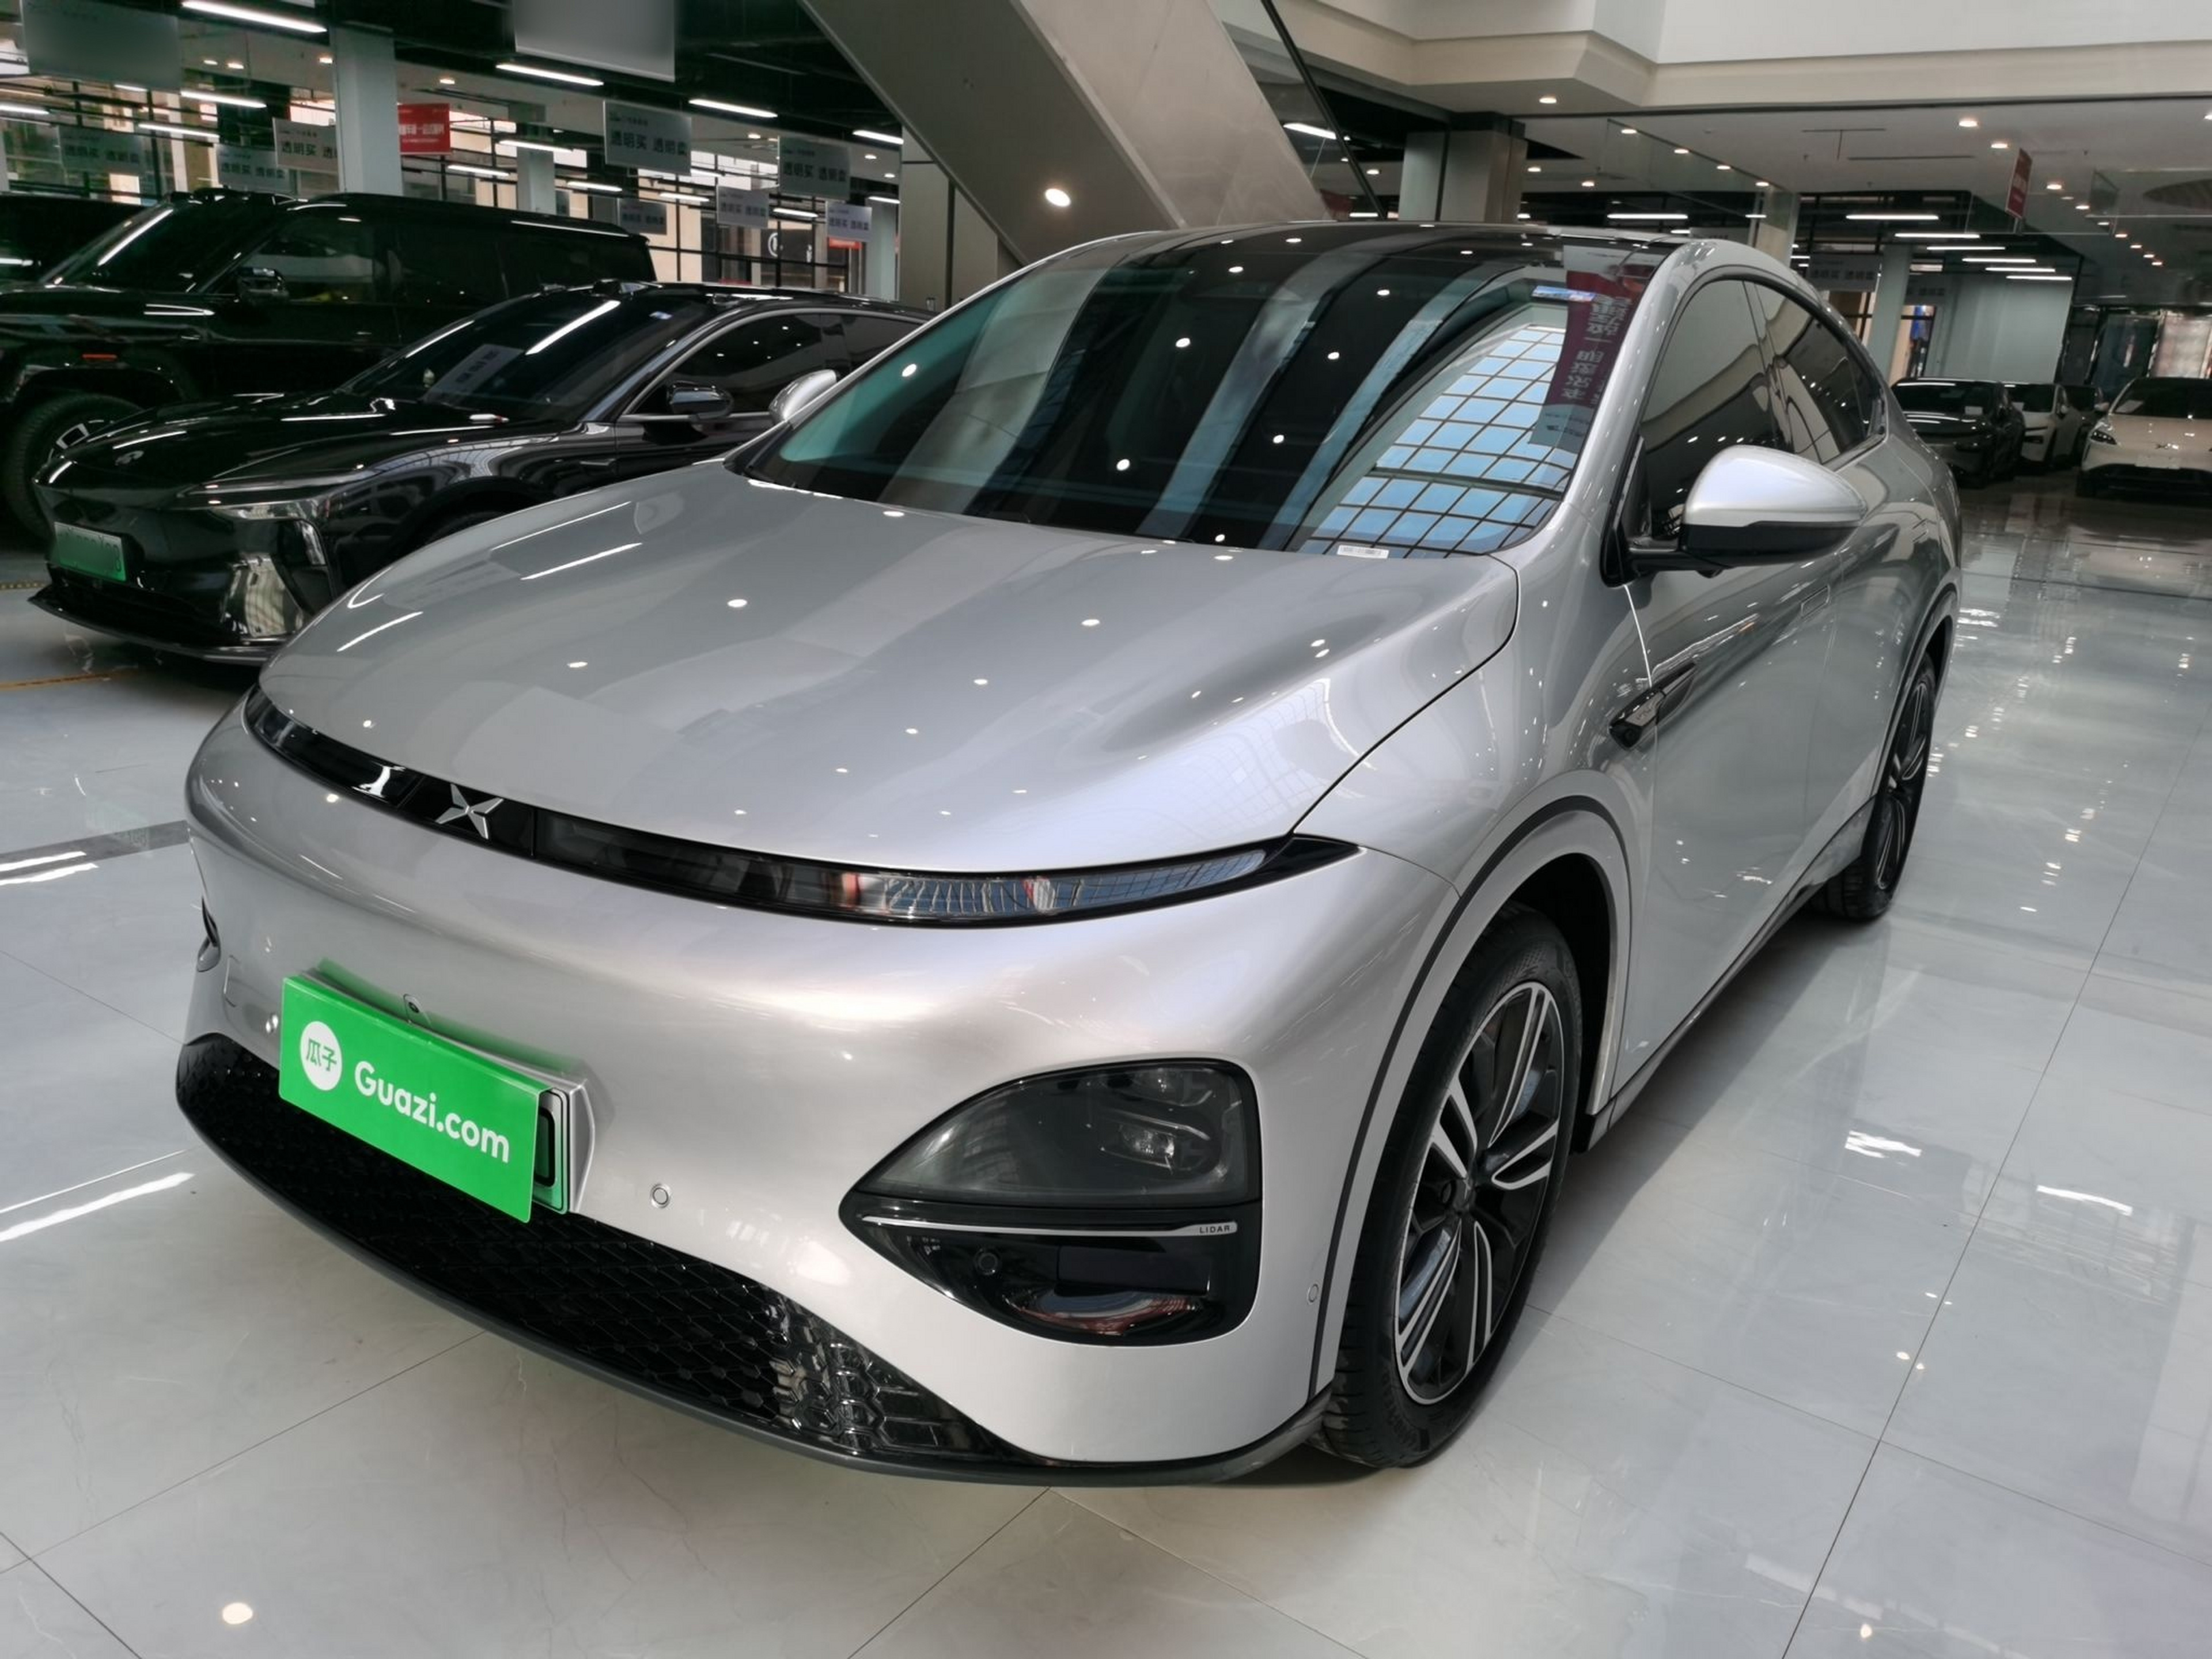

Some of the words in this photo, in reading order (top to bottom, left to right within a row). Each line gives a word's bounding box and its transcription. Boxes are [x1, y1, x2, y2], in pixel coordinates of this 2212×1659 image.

[305, 1038, 338, 1072] 瓜子
[354, 1060, 509, 1164] Guazi.com
[1200, 1225, 1230, 1233] LIDAR
